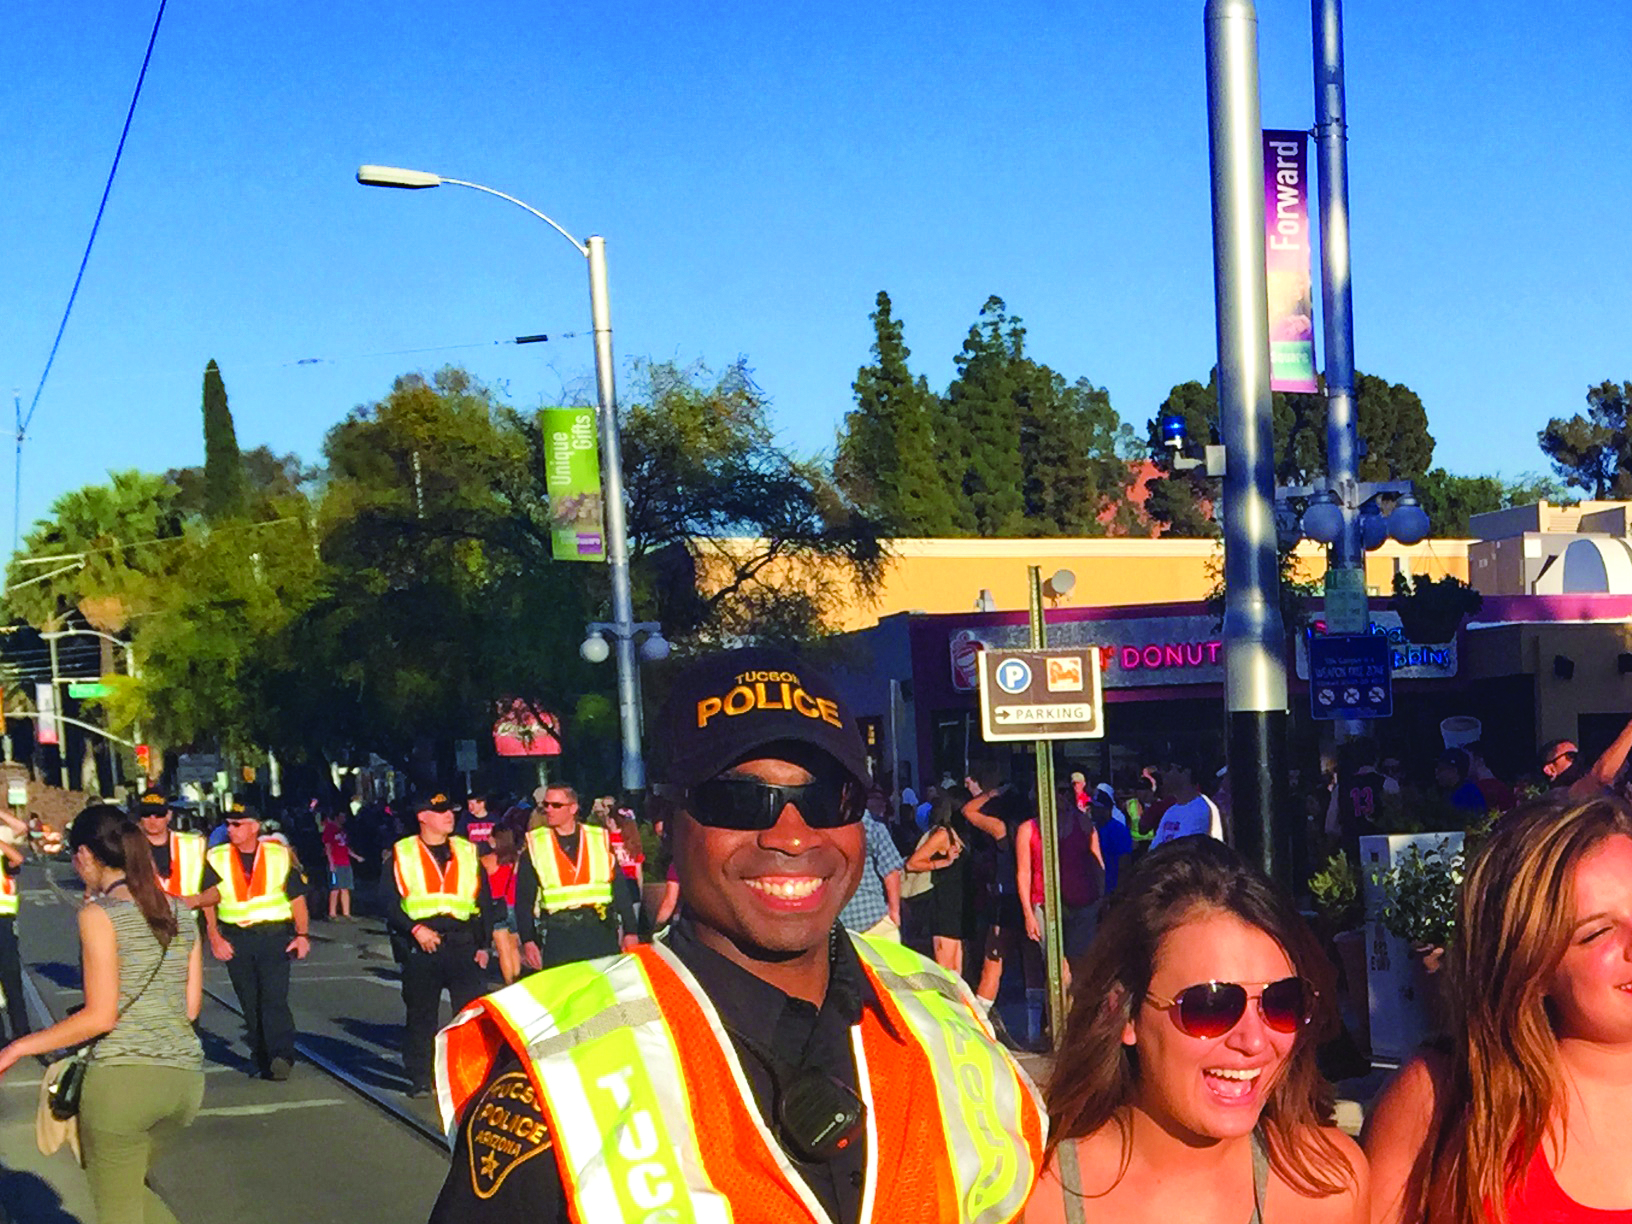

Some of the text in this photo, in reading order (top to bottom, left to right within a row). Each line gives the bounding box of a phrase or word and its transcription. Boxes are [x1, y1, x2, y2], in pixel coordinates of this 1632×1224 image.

[1269, 140, 1300, 251] Forward
[571, 414, 593, 450] Gifts
[551, 431, 575, 486] Unique
[1121, 641, 1221, 671] DONUT
[697, 682, 843, 729] POLICE
[1016, 707, 1084, 721] PARKING
[1350, 786, 1374, 817] 13
[479, 1103, 547, 1144] POLICE
